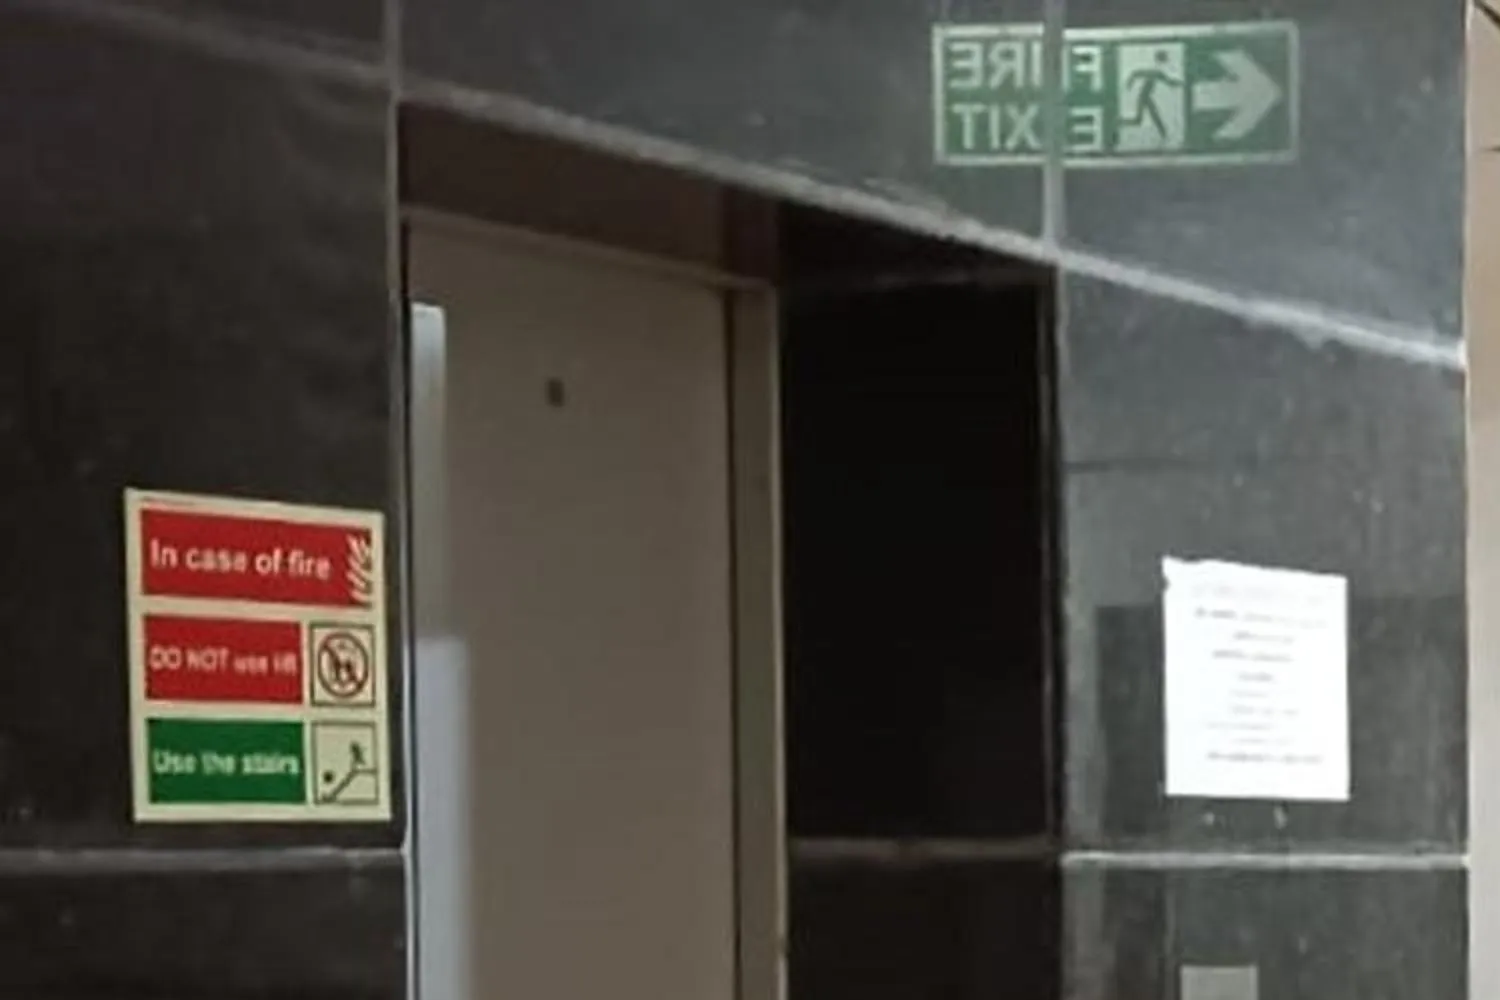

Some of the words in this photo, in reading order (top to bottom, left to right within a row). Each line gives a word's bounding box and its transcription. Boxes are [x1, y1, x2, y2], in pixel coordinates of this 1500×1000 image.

[151, 539, 178, 570] In
[186, 547, 247, 575] case
[255, 549, 284, 576] of
[288, 551, 333, 580] fire
[149, 646, 182, 671] DO
[186, 647, 229, 672] NOT
[234, 655, 268, 673] use
[153, 750, 196, 773] Use
[202, 752, 236, 774] the
[242, 751, 301, 775] stairs
